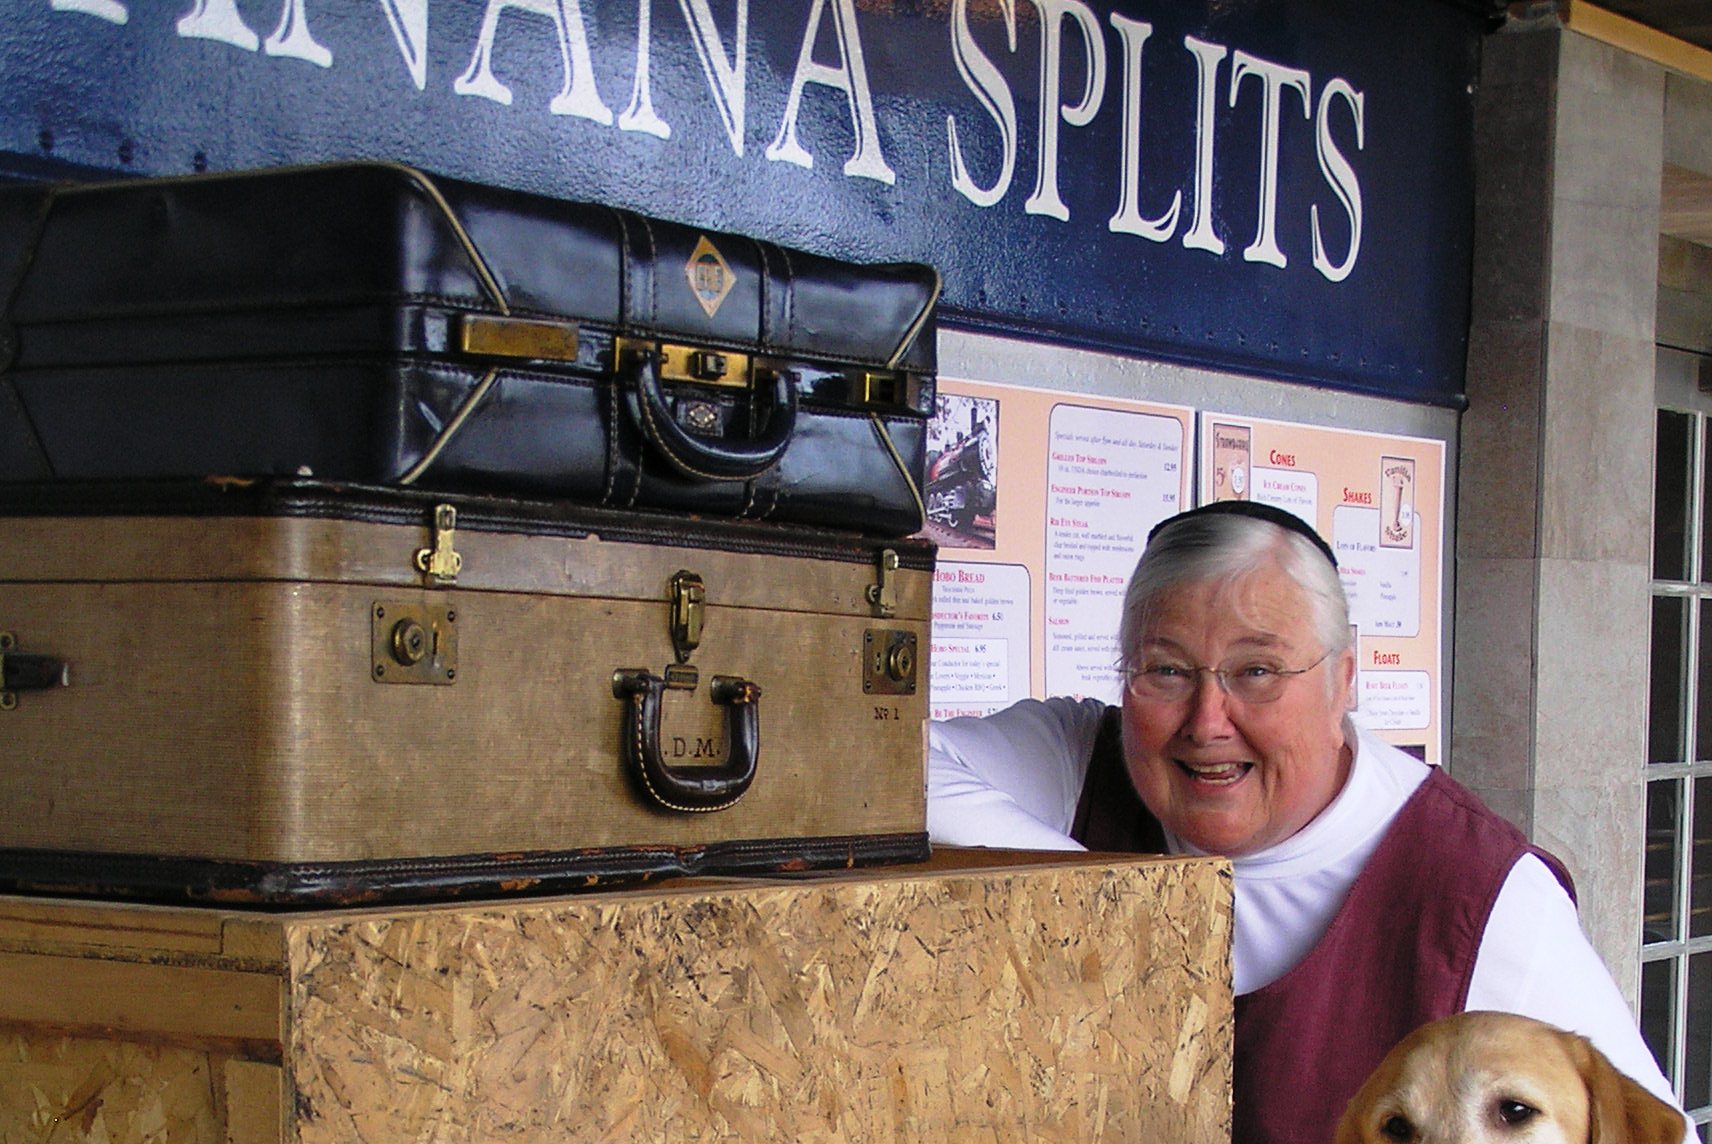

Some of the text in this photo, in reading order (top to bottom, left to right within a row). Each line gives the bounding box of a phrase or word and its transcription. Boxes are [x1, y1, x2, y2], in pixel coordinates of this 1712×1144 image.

[947, 0, 1364, 283] SPLITS
[1270, 449, 1296, 466] CONES
[1343, 487, 1372, 504] SHAKES
[958, 570, 985, 583] BREAD
[1373, 650, 1400, 664] FLOATS
[935, 709, 942, 718] BE
